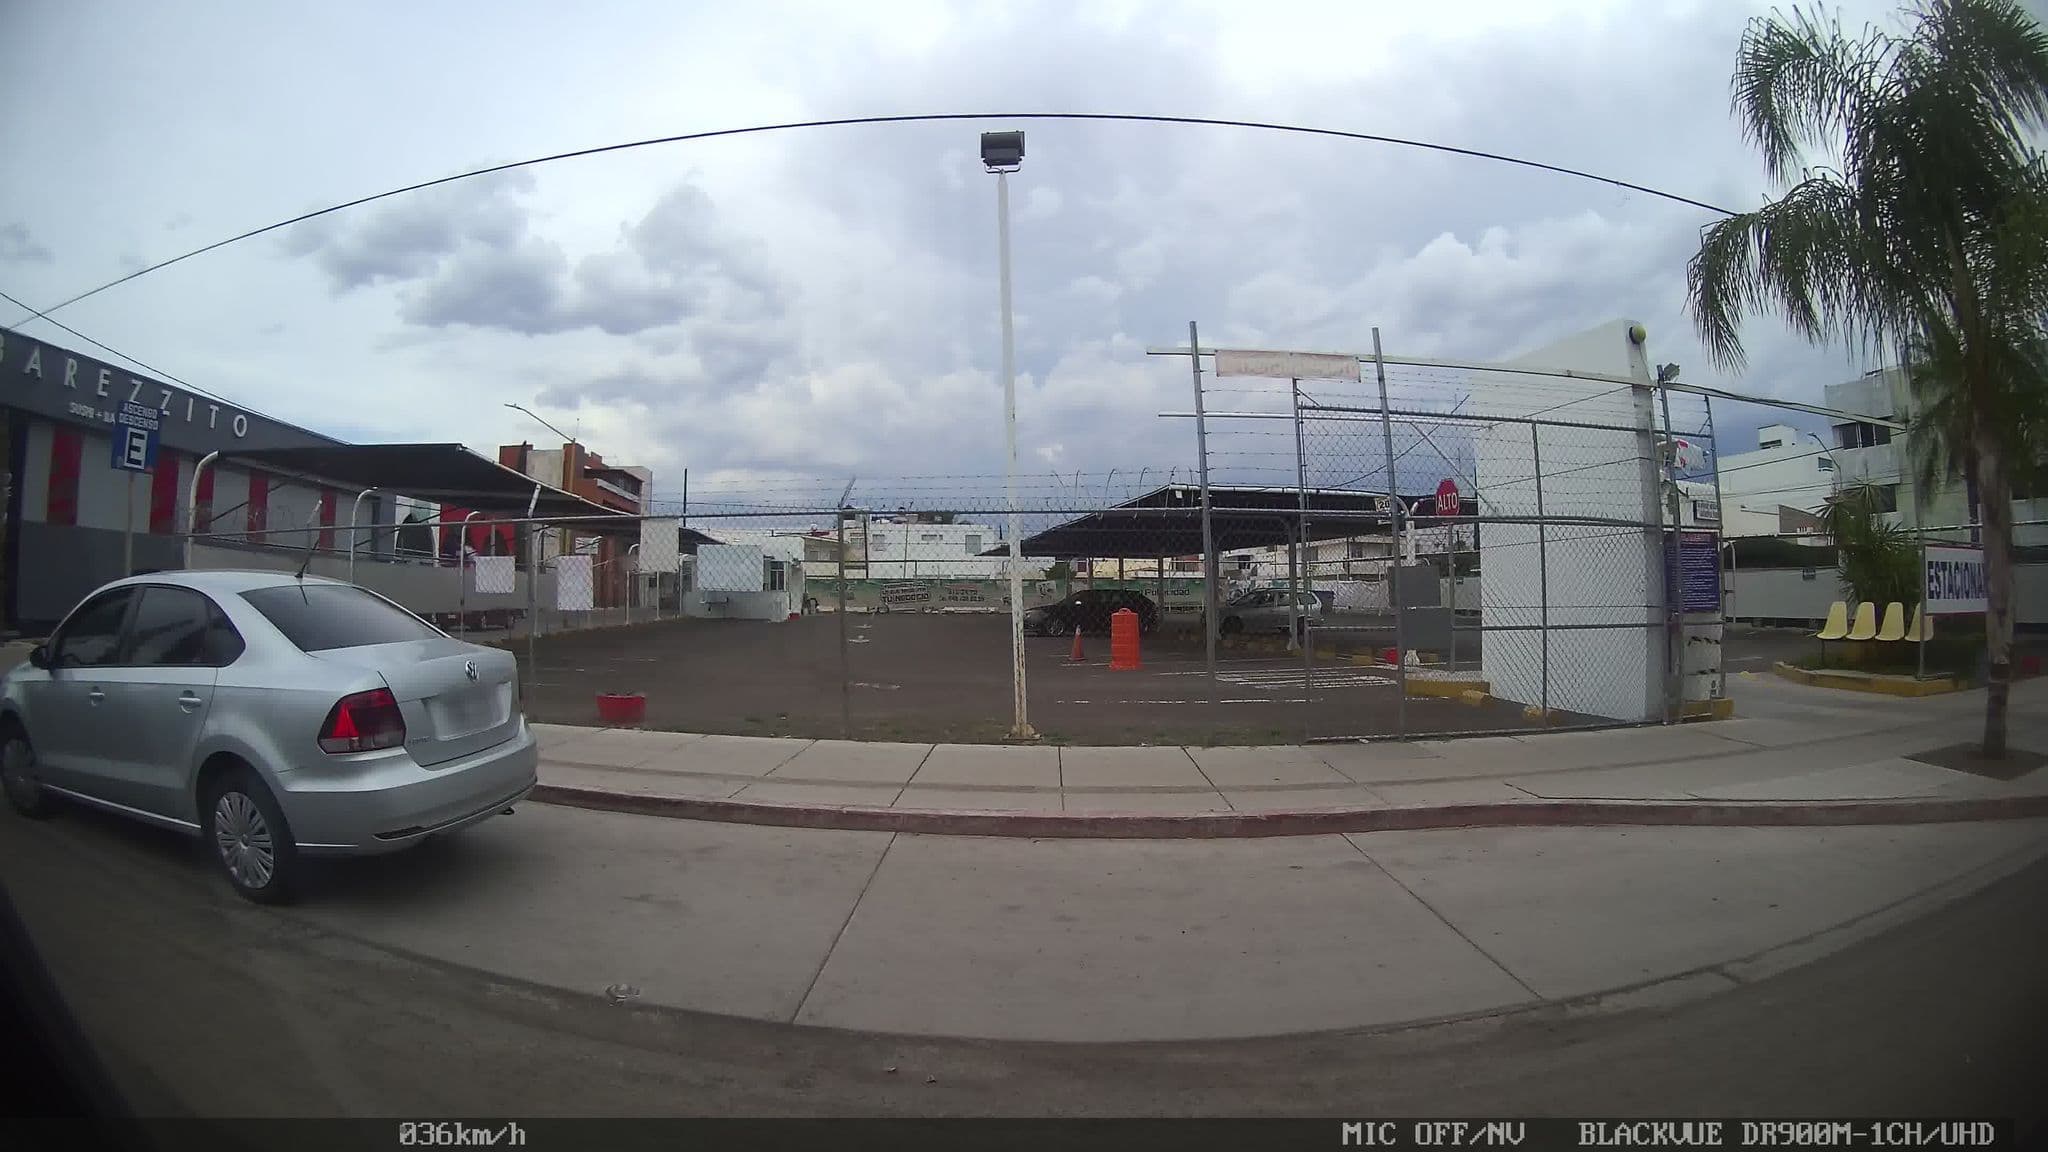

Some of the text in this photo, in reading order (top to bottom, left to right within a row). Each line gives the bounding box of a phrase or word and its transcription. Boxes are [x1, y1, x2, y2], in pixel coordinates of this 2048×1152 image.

[123, 402, 158, 419] ASCENSO
[119, 412, 159, 430] DESCENSO
[126, 431, 146, 466] E
[1437, 492, 1458, 511] ALTO
[1927, 560, 1988, 601] ESTACIONA
